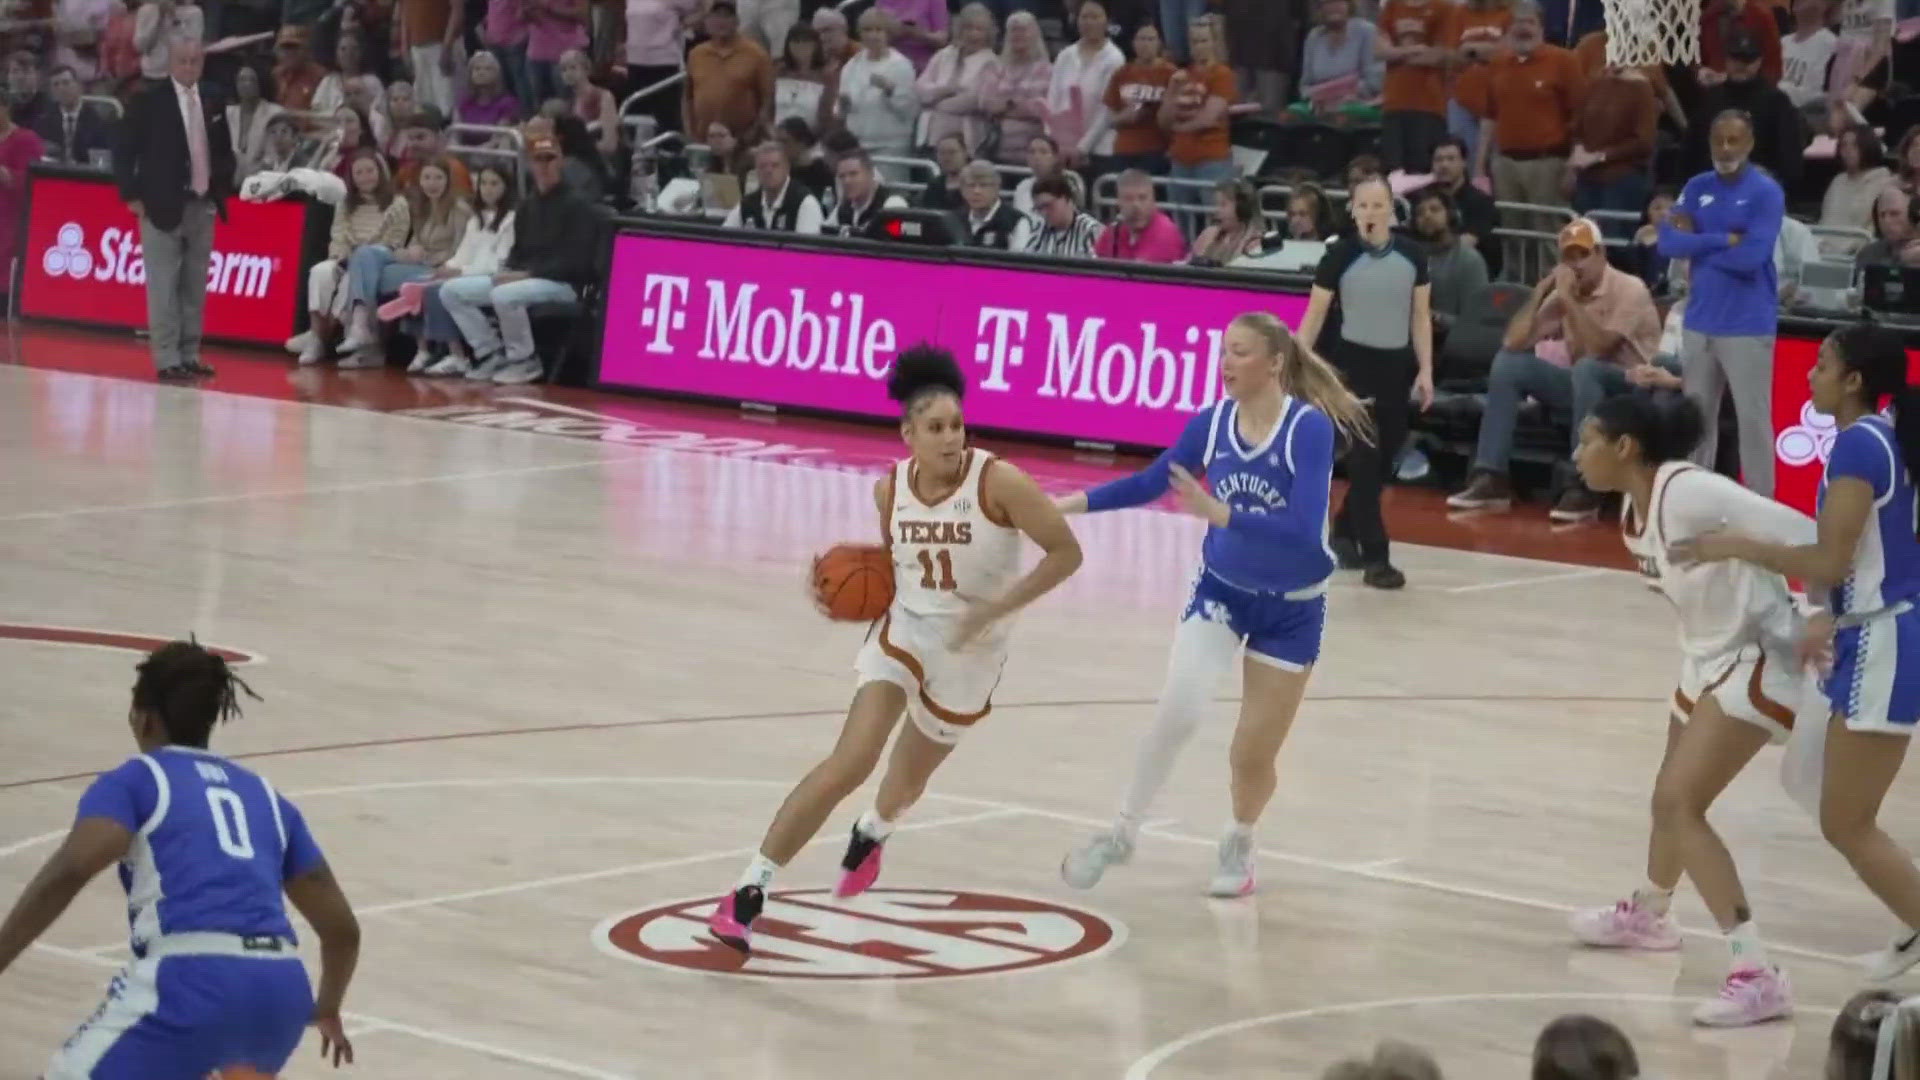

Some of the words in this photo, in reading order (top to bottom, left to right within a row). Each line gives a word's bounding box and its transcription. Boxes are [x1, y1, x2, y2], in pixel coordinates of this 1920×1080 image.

[94, 227, 147, 285] Sta
[206, 250, 272, 299] arm
[641, 273, 690, 355] T
[697, 279, 897, 380] Mobile
[974, 305, 1029, 392] T
[1037, 312, 1225, 414] Mobil
[898, 520, 972, 545] TEXAS
[917, 548, 957, 590] 11
[206, 786, 255, 858] 0
